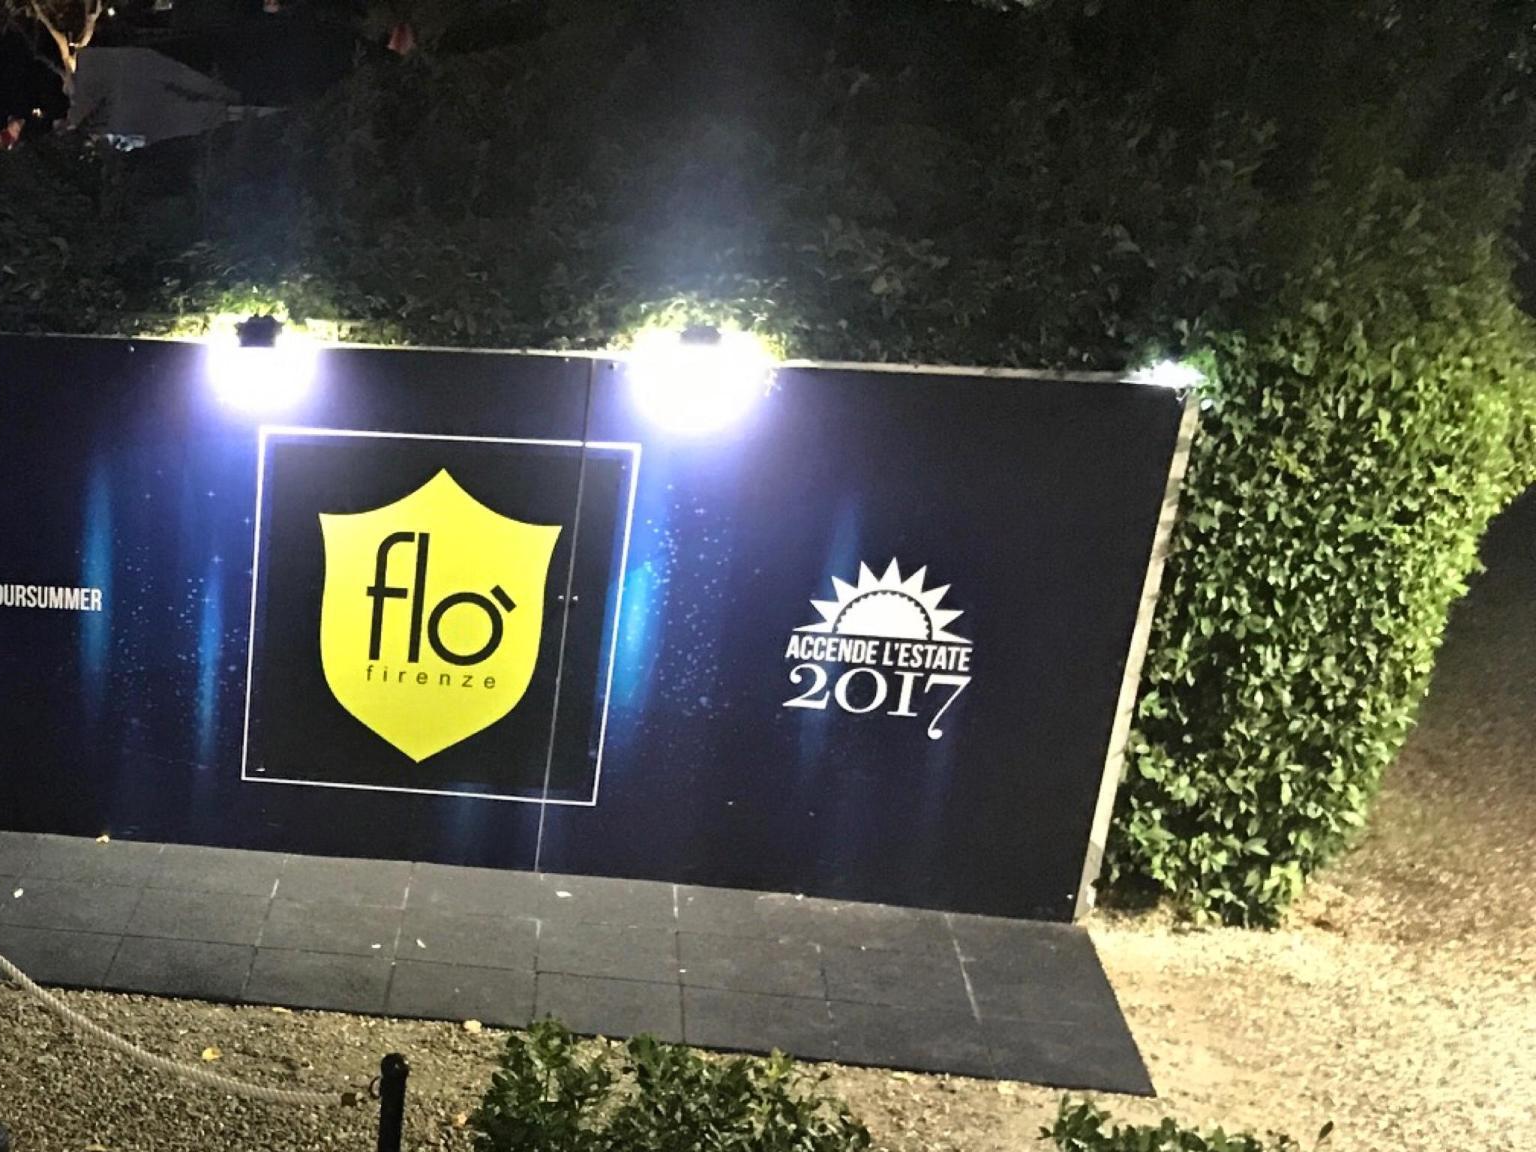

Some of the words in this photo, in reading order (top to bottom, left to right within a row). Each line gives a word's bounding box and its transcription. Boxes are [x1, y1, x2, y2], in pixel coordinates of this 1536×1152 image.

[785, 634, 879, 665] ACCENDE
[882, 641, 973, 672] L'ESTATE
[366, 664, 496, 690] firenze
[782, 663, 973, 740] 2017
